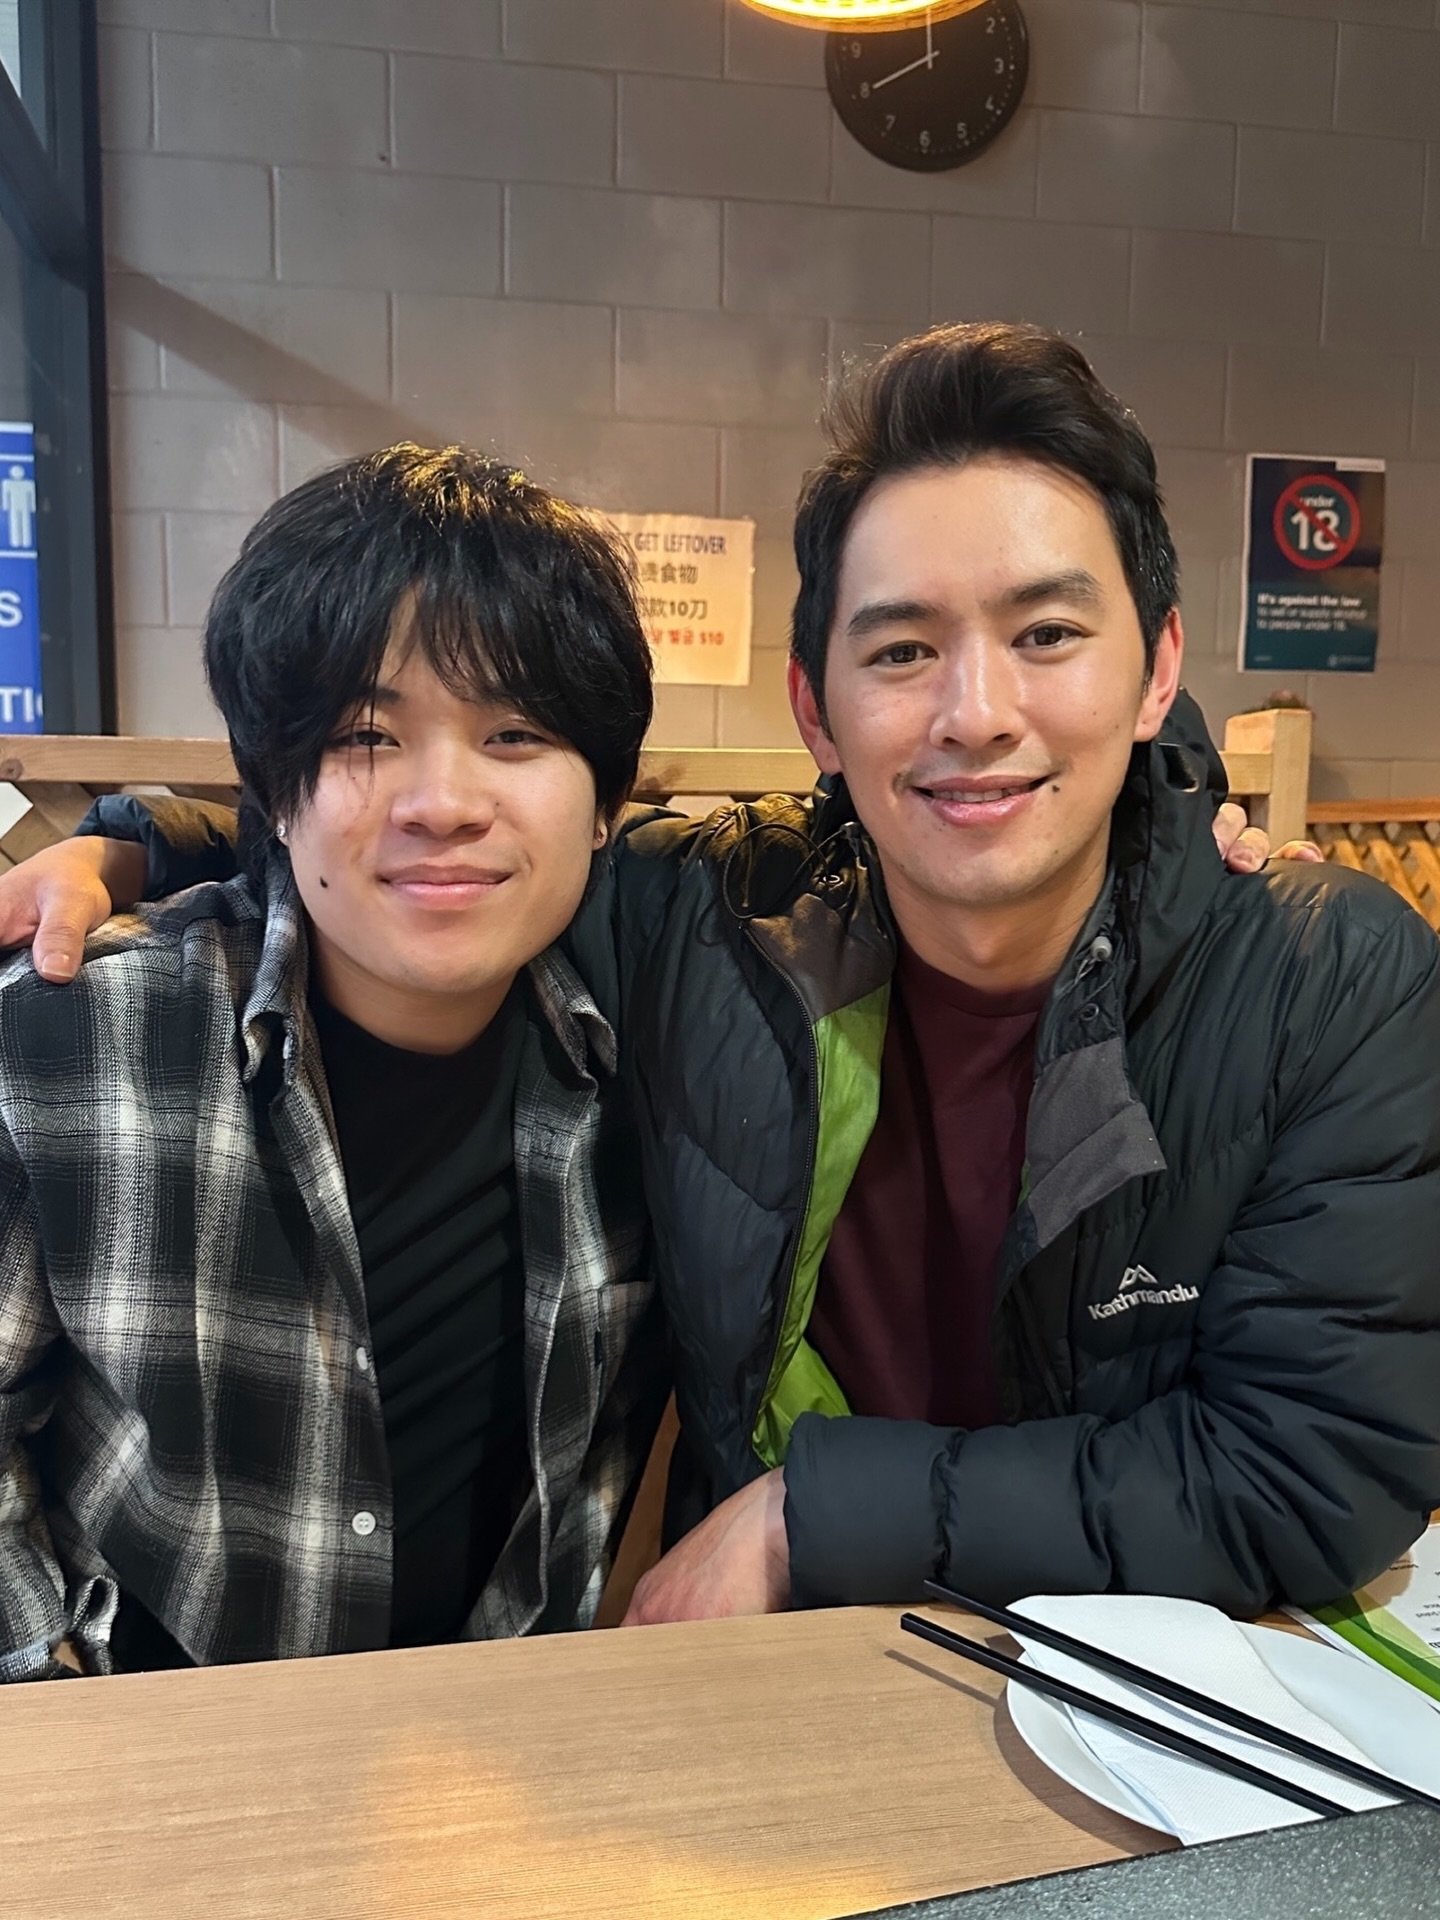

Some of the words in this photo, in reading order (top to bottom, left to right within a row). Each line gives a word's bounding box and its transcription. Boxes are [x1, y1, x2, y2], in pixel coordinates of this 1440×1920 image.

[986, 17, 996, 34] 2
[851, 42, 861, 58] 9
[994, 58, 1004, 74] 3
[860, 82, 870, 98] 8
[985, 96, 994, 111] 4
[886, 115, 896, 130] 7
[957, 122, 968, 139] 5
[919, 131, 930, 147] 6
[1291, 510, 1339, 551] 18
[634, 532, 658, 551] GET
[663, 533, 726, 554] LEFTOVER
[1278, 594, 1318, 607] against
[1320, 595, 1338, 606] the
[1341, 596, 1361, 607] law
[1088, 1283, 1199, 1320] Kathmandu
